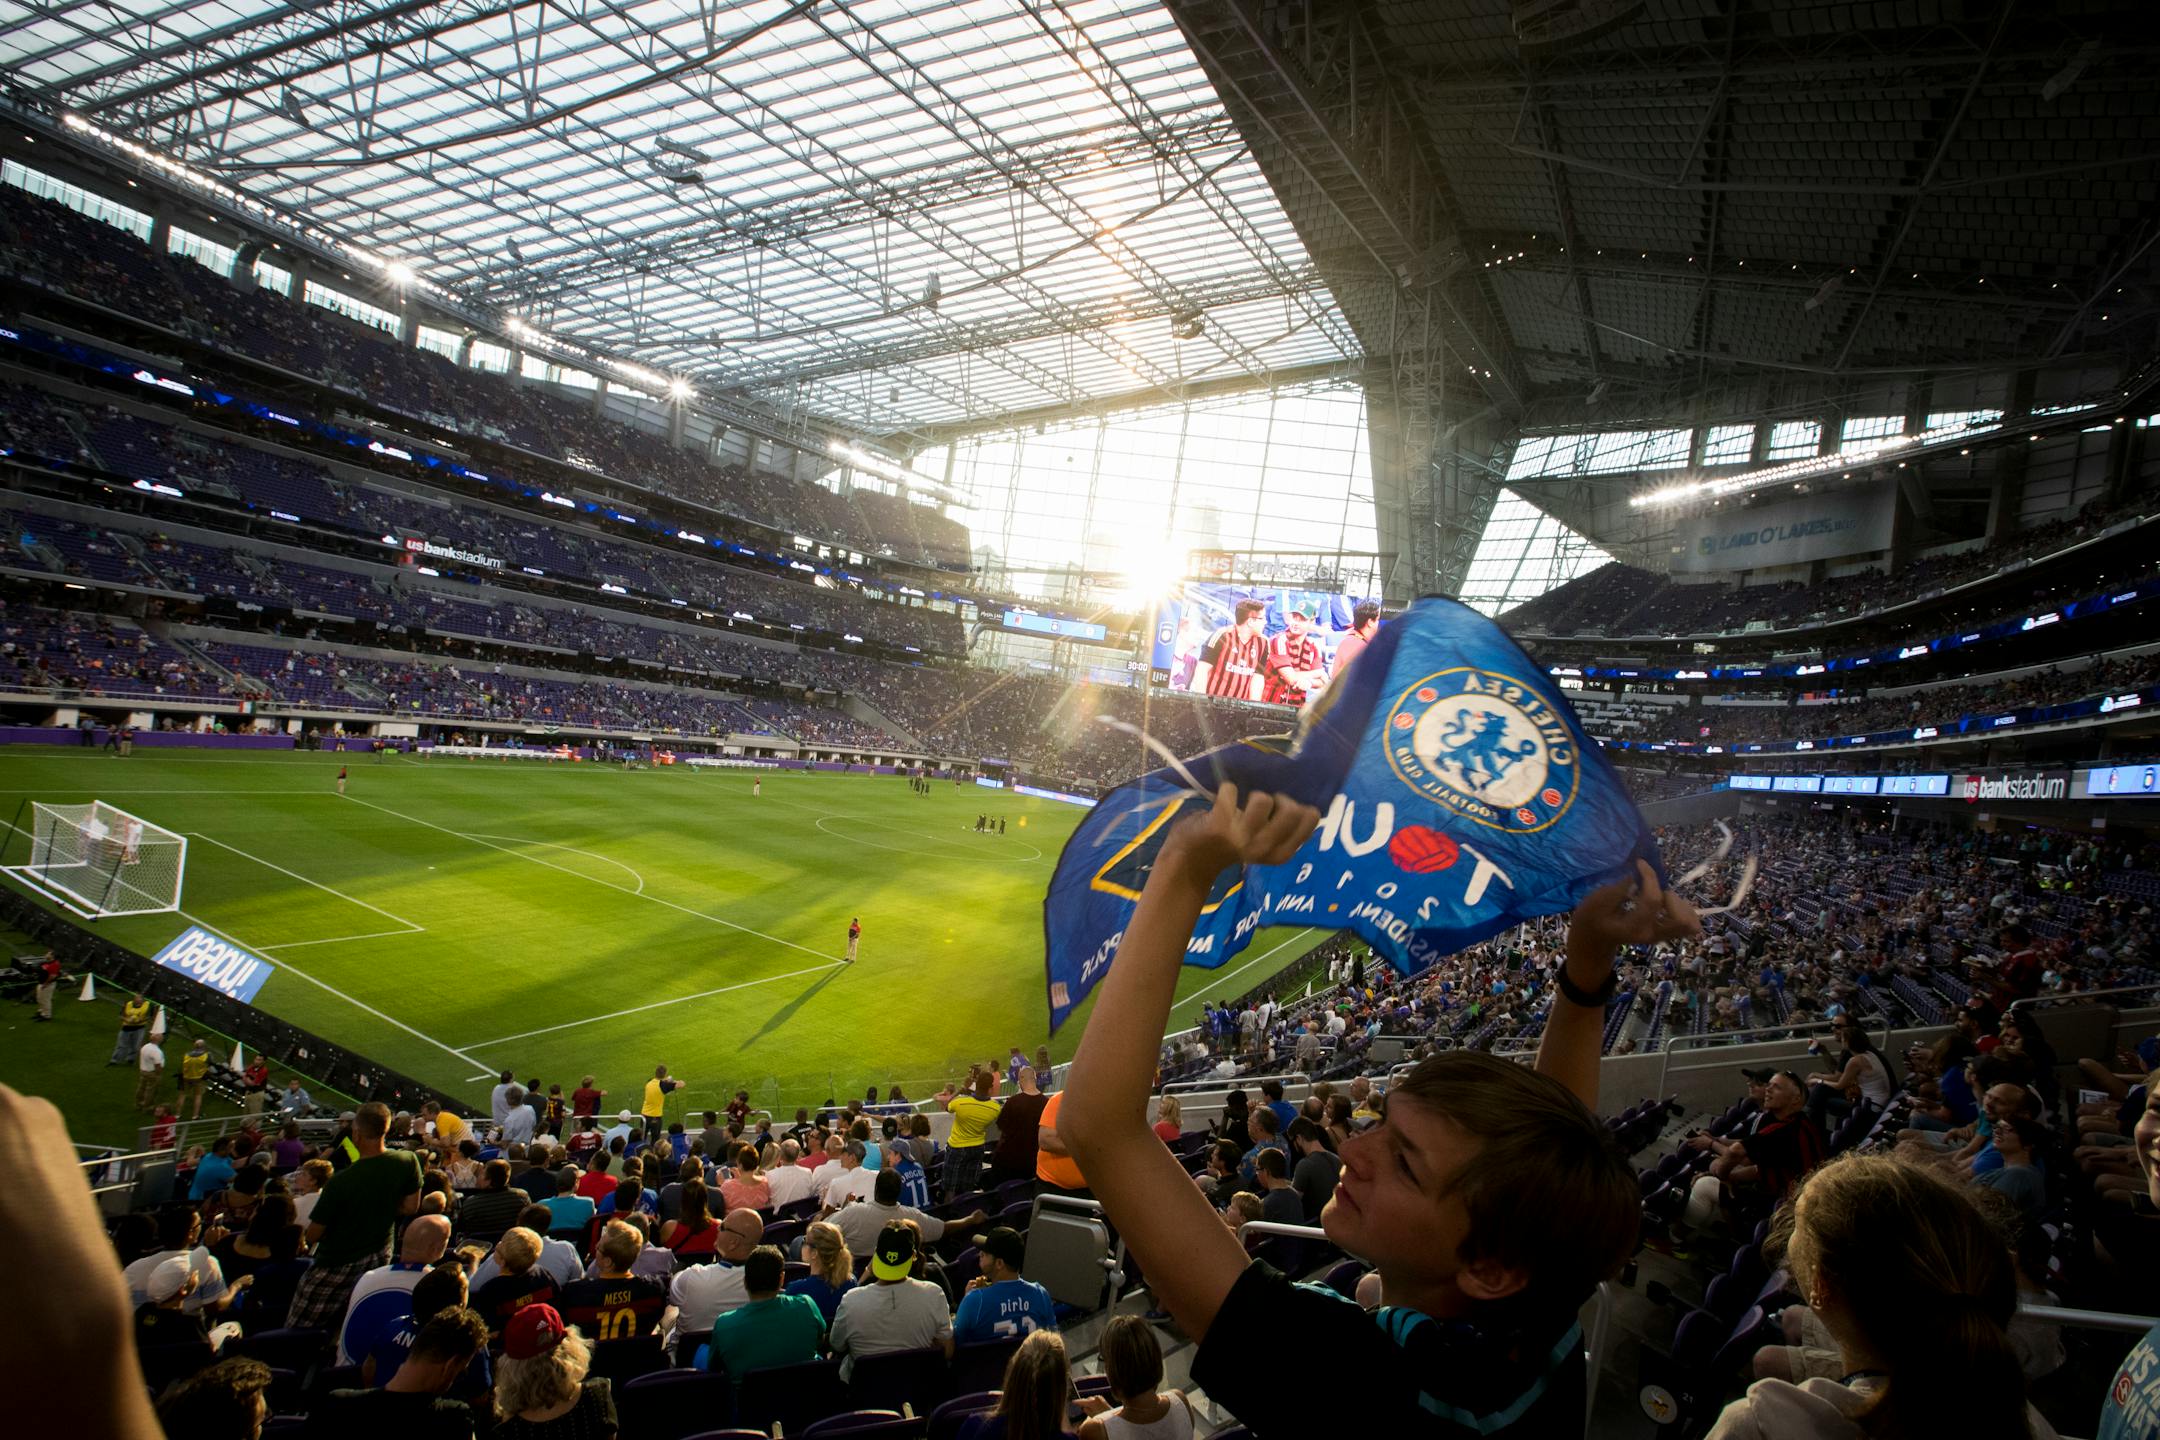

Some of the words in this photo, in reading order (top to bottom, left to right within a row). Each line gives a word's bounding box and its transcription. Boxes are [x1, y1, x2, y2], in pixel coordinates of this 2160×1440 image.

[156, 929, 260, 998] indeed
[906, 1178, 931, 1209] 11
[603, 1290, 632, 1306] MESSI
[1000, 1297, 1030, 1317] pirlo
[595, 1307, 637, 1341] 10
